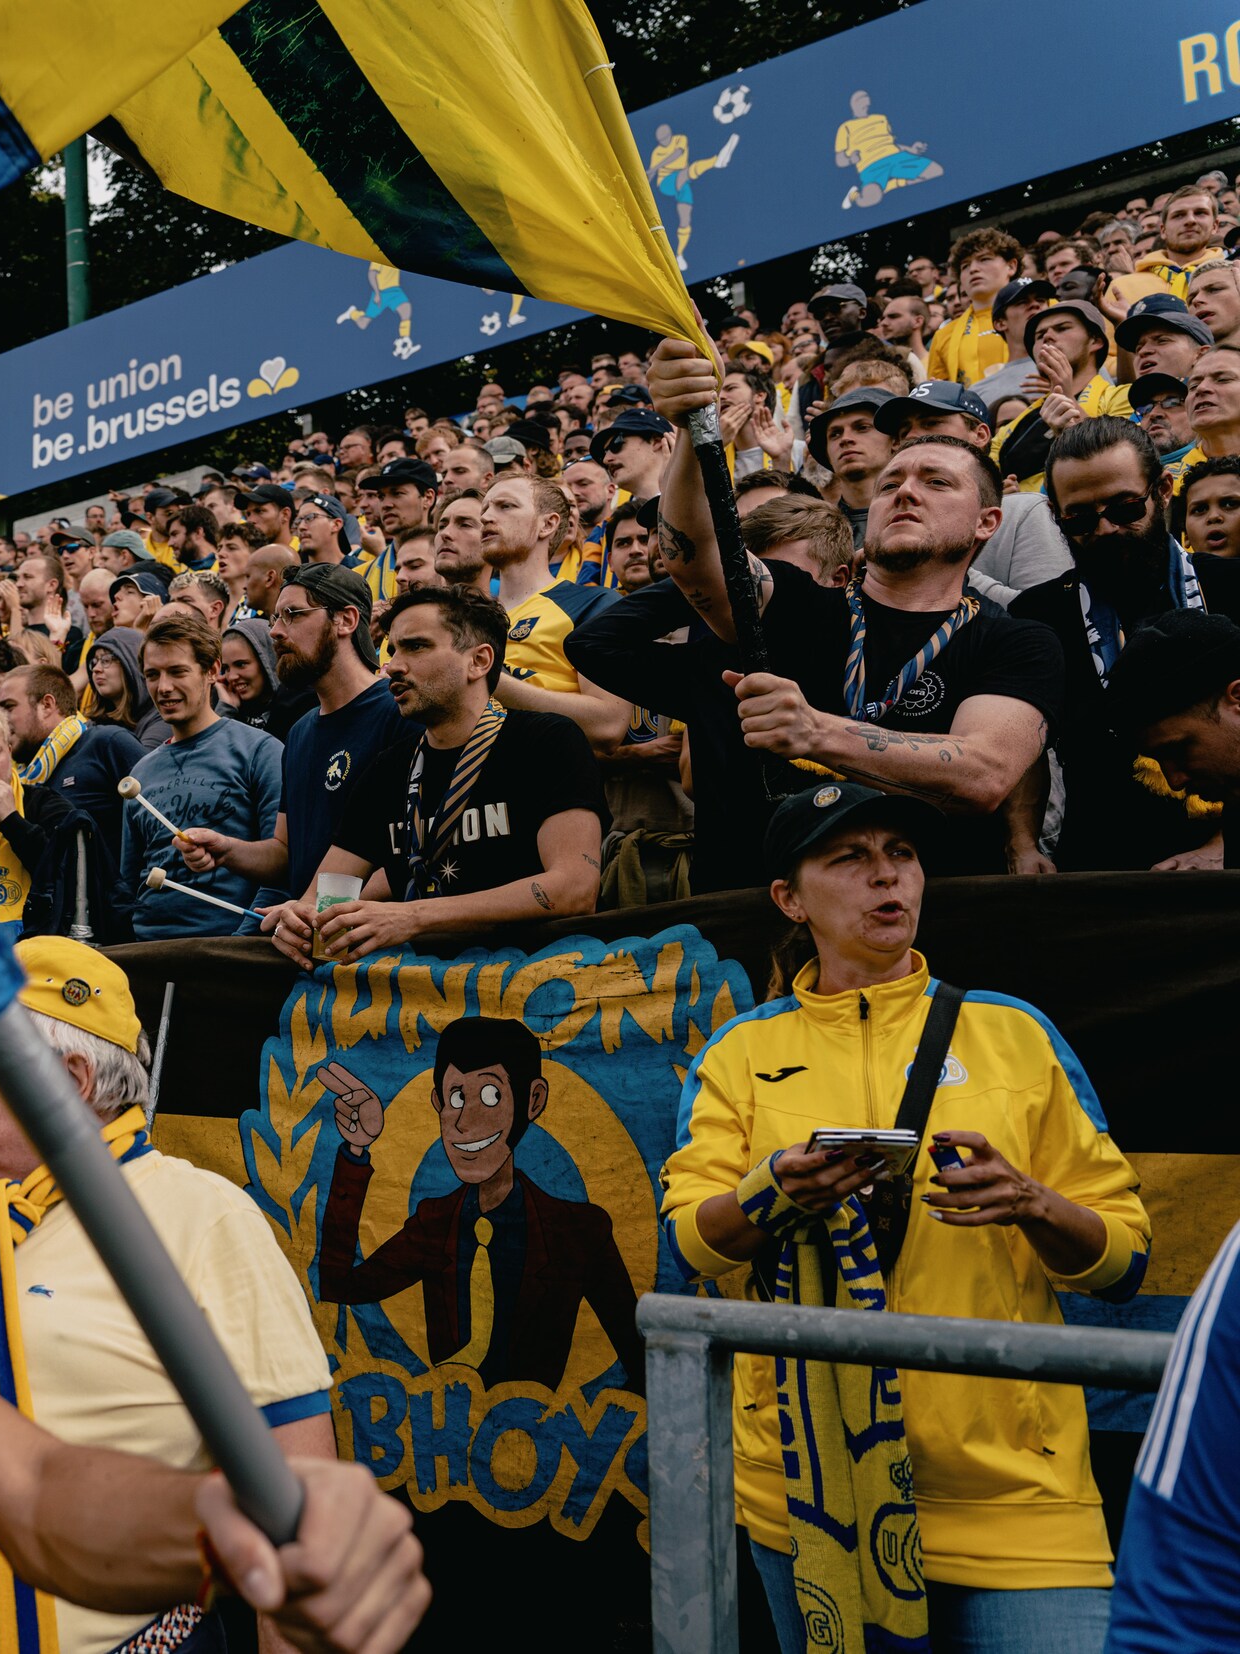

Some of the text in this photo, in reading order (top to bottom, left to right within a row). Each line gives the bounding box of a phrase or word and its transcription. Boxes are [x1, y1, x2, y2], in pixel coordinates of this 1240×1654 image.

[32, 374, 241, 469] be.brussels
[33, 354, 182, 428] be union
[332, 941, 684, 1055] UNION
